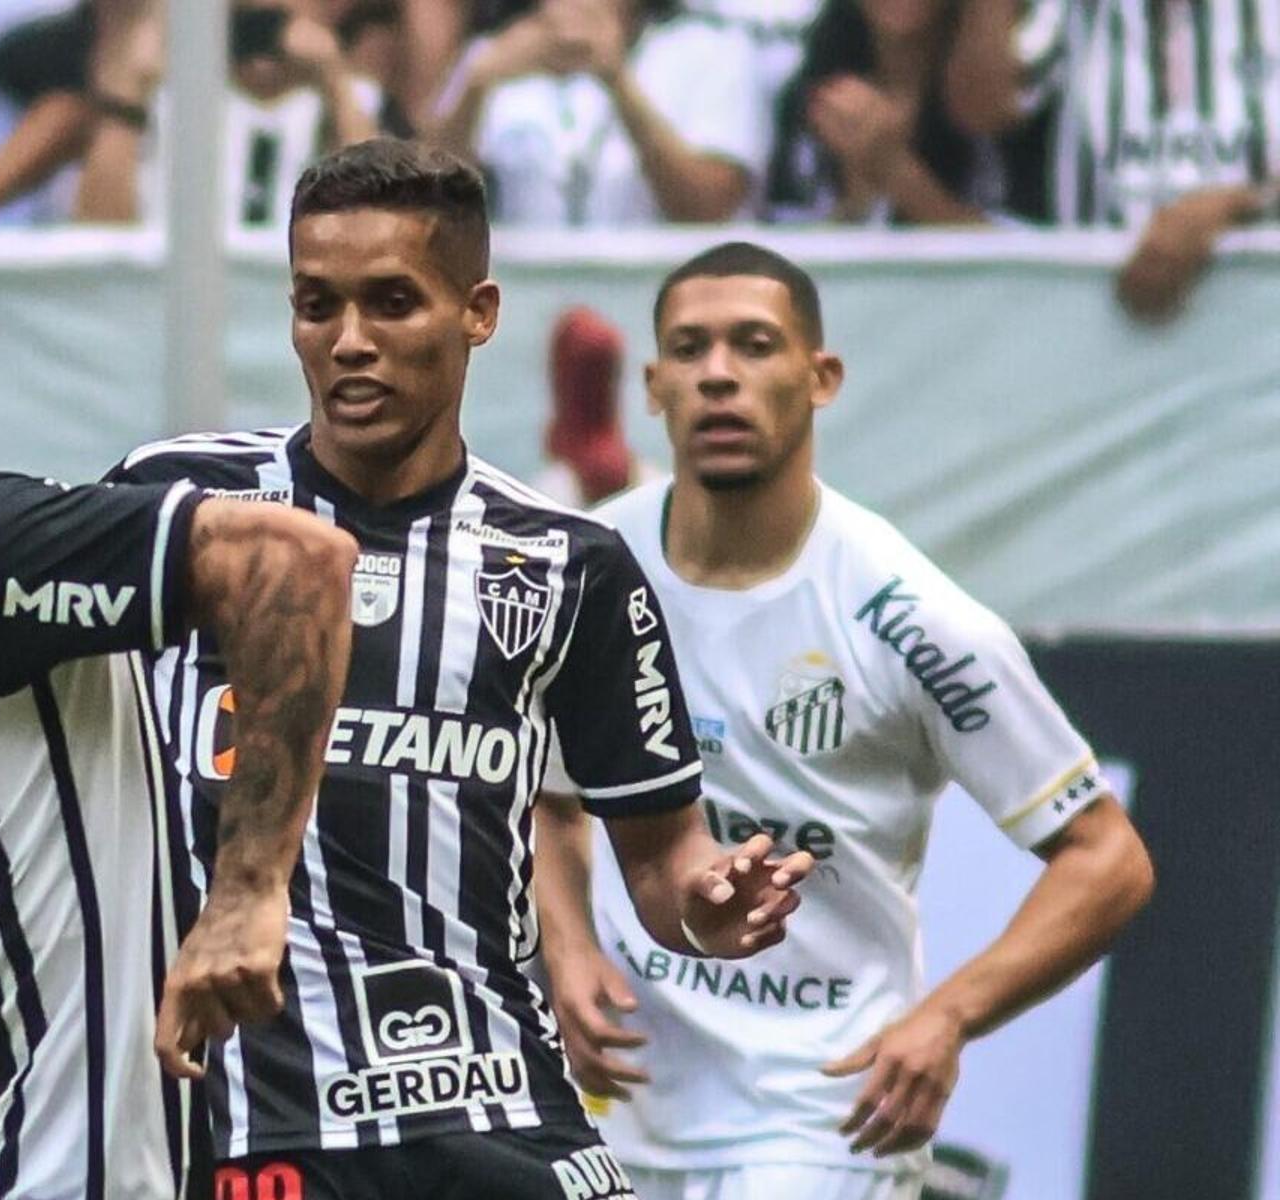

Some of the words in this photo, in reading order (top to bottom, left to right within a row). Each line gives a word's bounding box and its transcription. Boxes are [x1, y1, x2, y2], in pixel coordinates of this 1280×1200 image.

[3, 577, 137, 627] MRV
[487, 582, 541, 607] CAM
[853, 575, 999, 733] Kicaldo
[634, 641, 681, 762] MRV
[324, 708, 517, 785] ETANO
[704, 799, 836, 860] laze
[643, 951, 852, 1010] BINANCE
[326, 1057, 524, 1117] GERDAU
